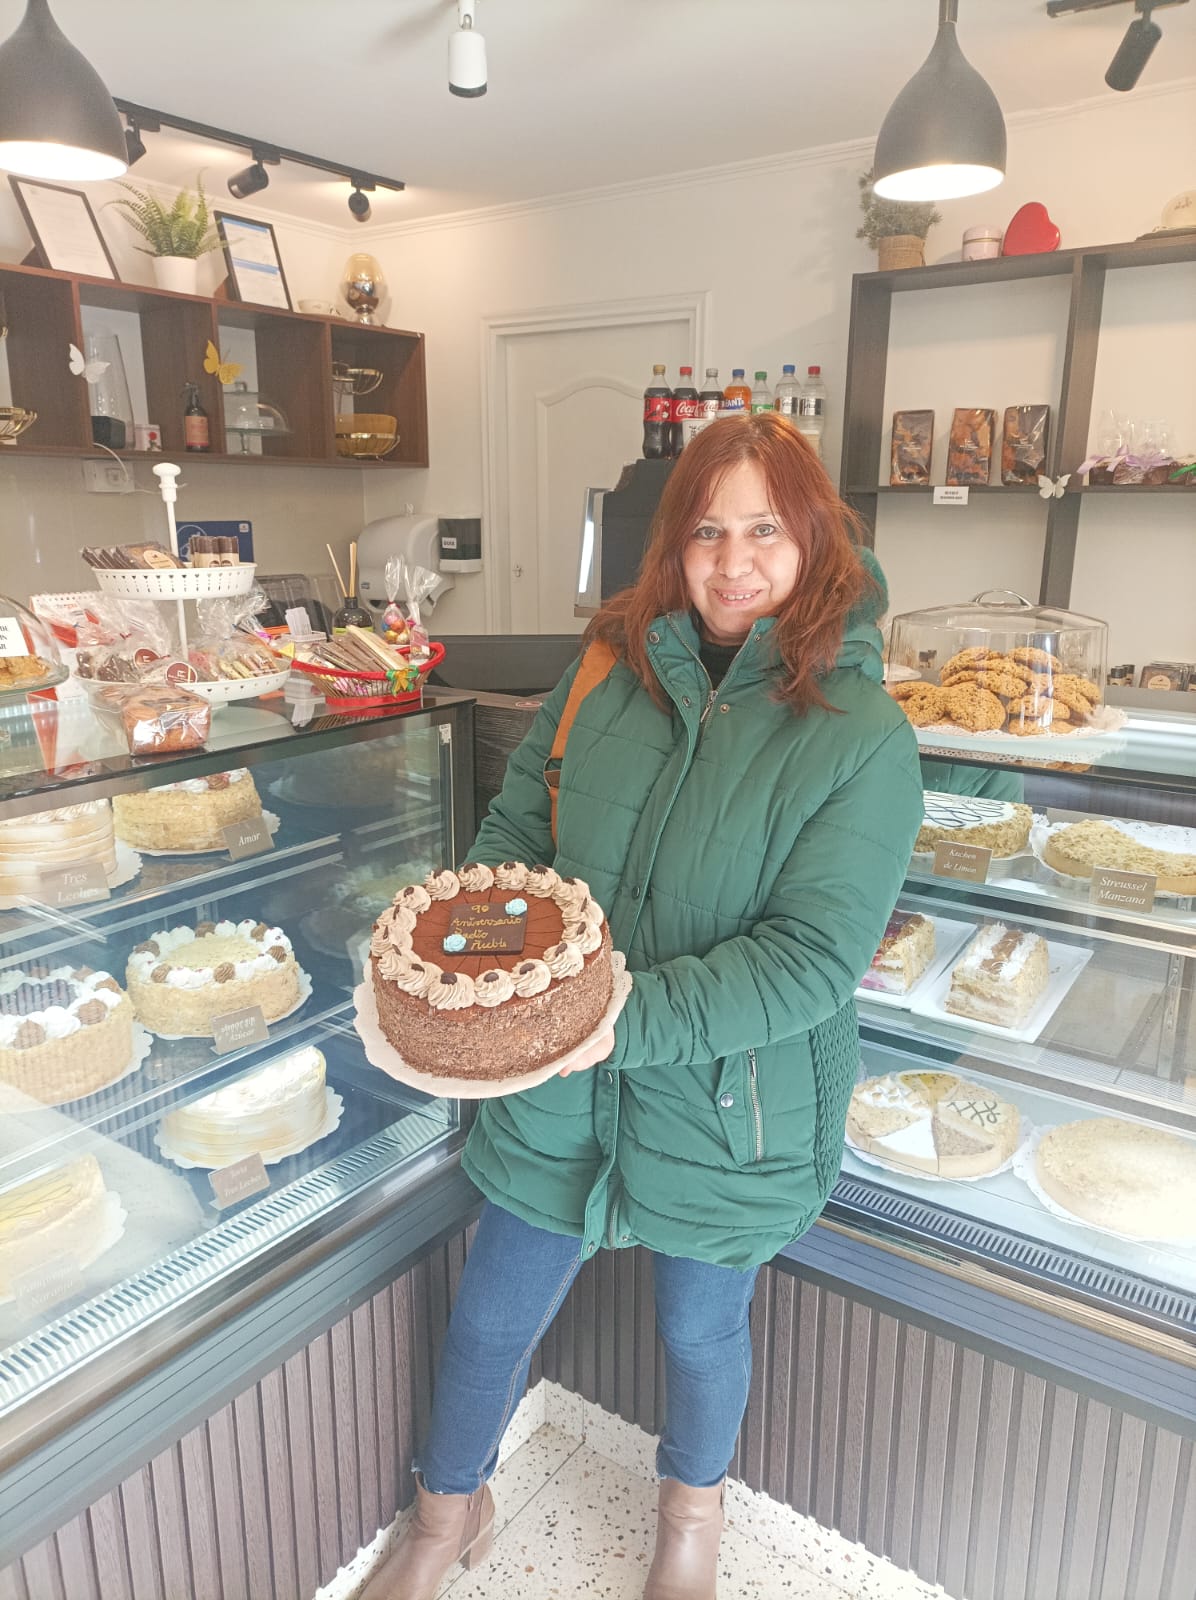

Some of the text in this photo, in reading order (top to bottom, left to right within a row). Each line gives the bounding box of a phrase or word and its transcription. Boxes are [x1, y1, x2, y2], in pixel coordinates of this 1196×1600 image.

[239, 832, 260, 847] Amor
[949, 849, 976, 860] Kuchen
[943, 861, 952, 870] de
[63, 871, 87, 885] Tres
[1100, 876, 1148, 891] Streussel
[1099, 889, 1146, 905] Manzana
[471, 904, 489, 914] 90
[451, 915, 523, 927] Aniversario
